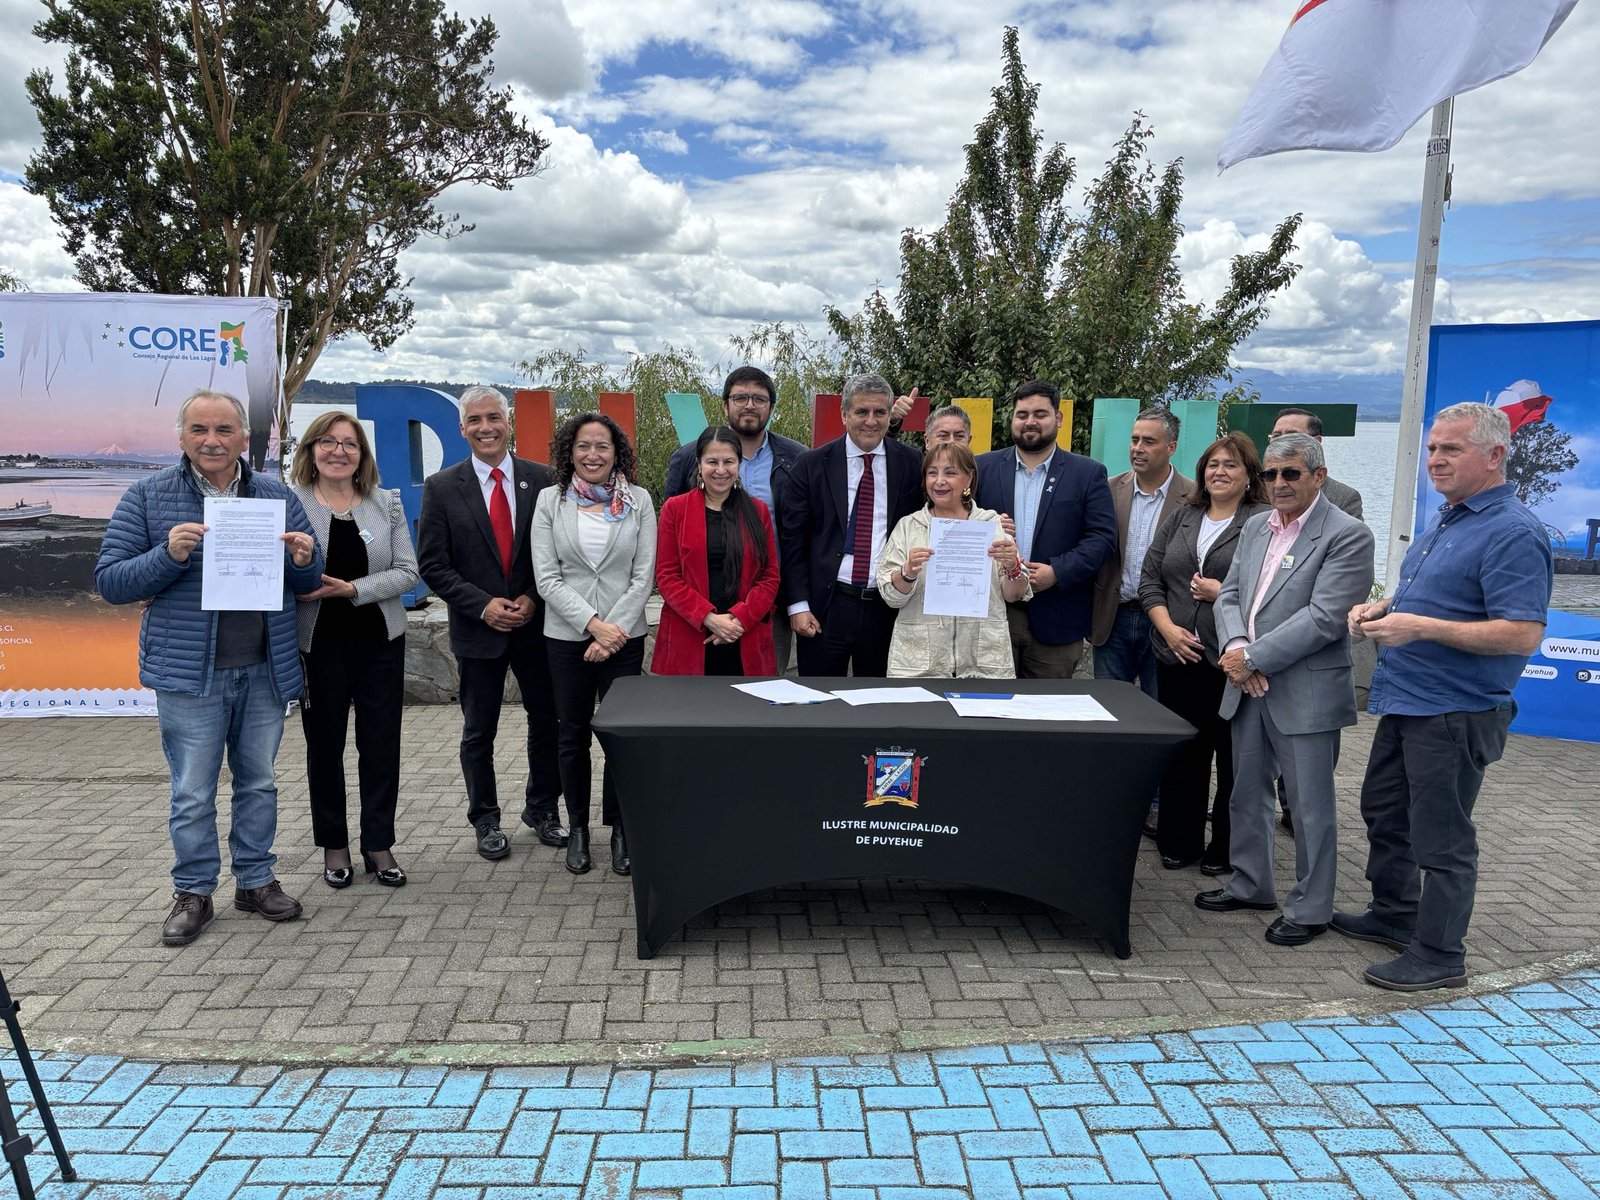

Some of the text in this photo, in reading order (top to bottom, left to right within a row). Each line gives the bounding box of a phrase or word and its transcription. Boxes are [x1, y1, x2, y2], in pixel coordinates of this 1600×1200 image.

[1430, 139, 1447, 156] KIDS
[128, 326, 216, 352] CORE
[157, 353, 180, 361] Regional
[1524, 668, 1554, 677] uyehue
[822, 820, 959, 835] ILUSTRE MUNICIPALIDAD
[856, 836, 924, 848] DE PUYEHUE
